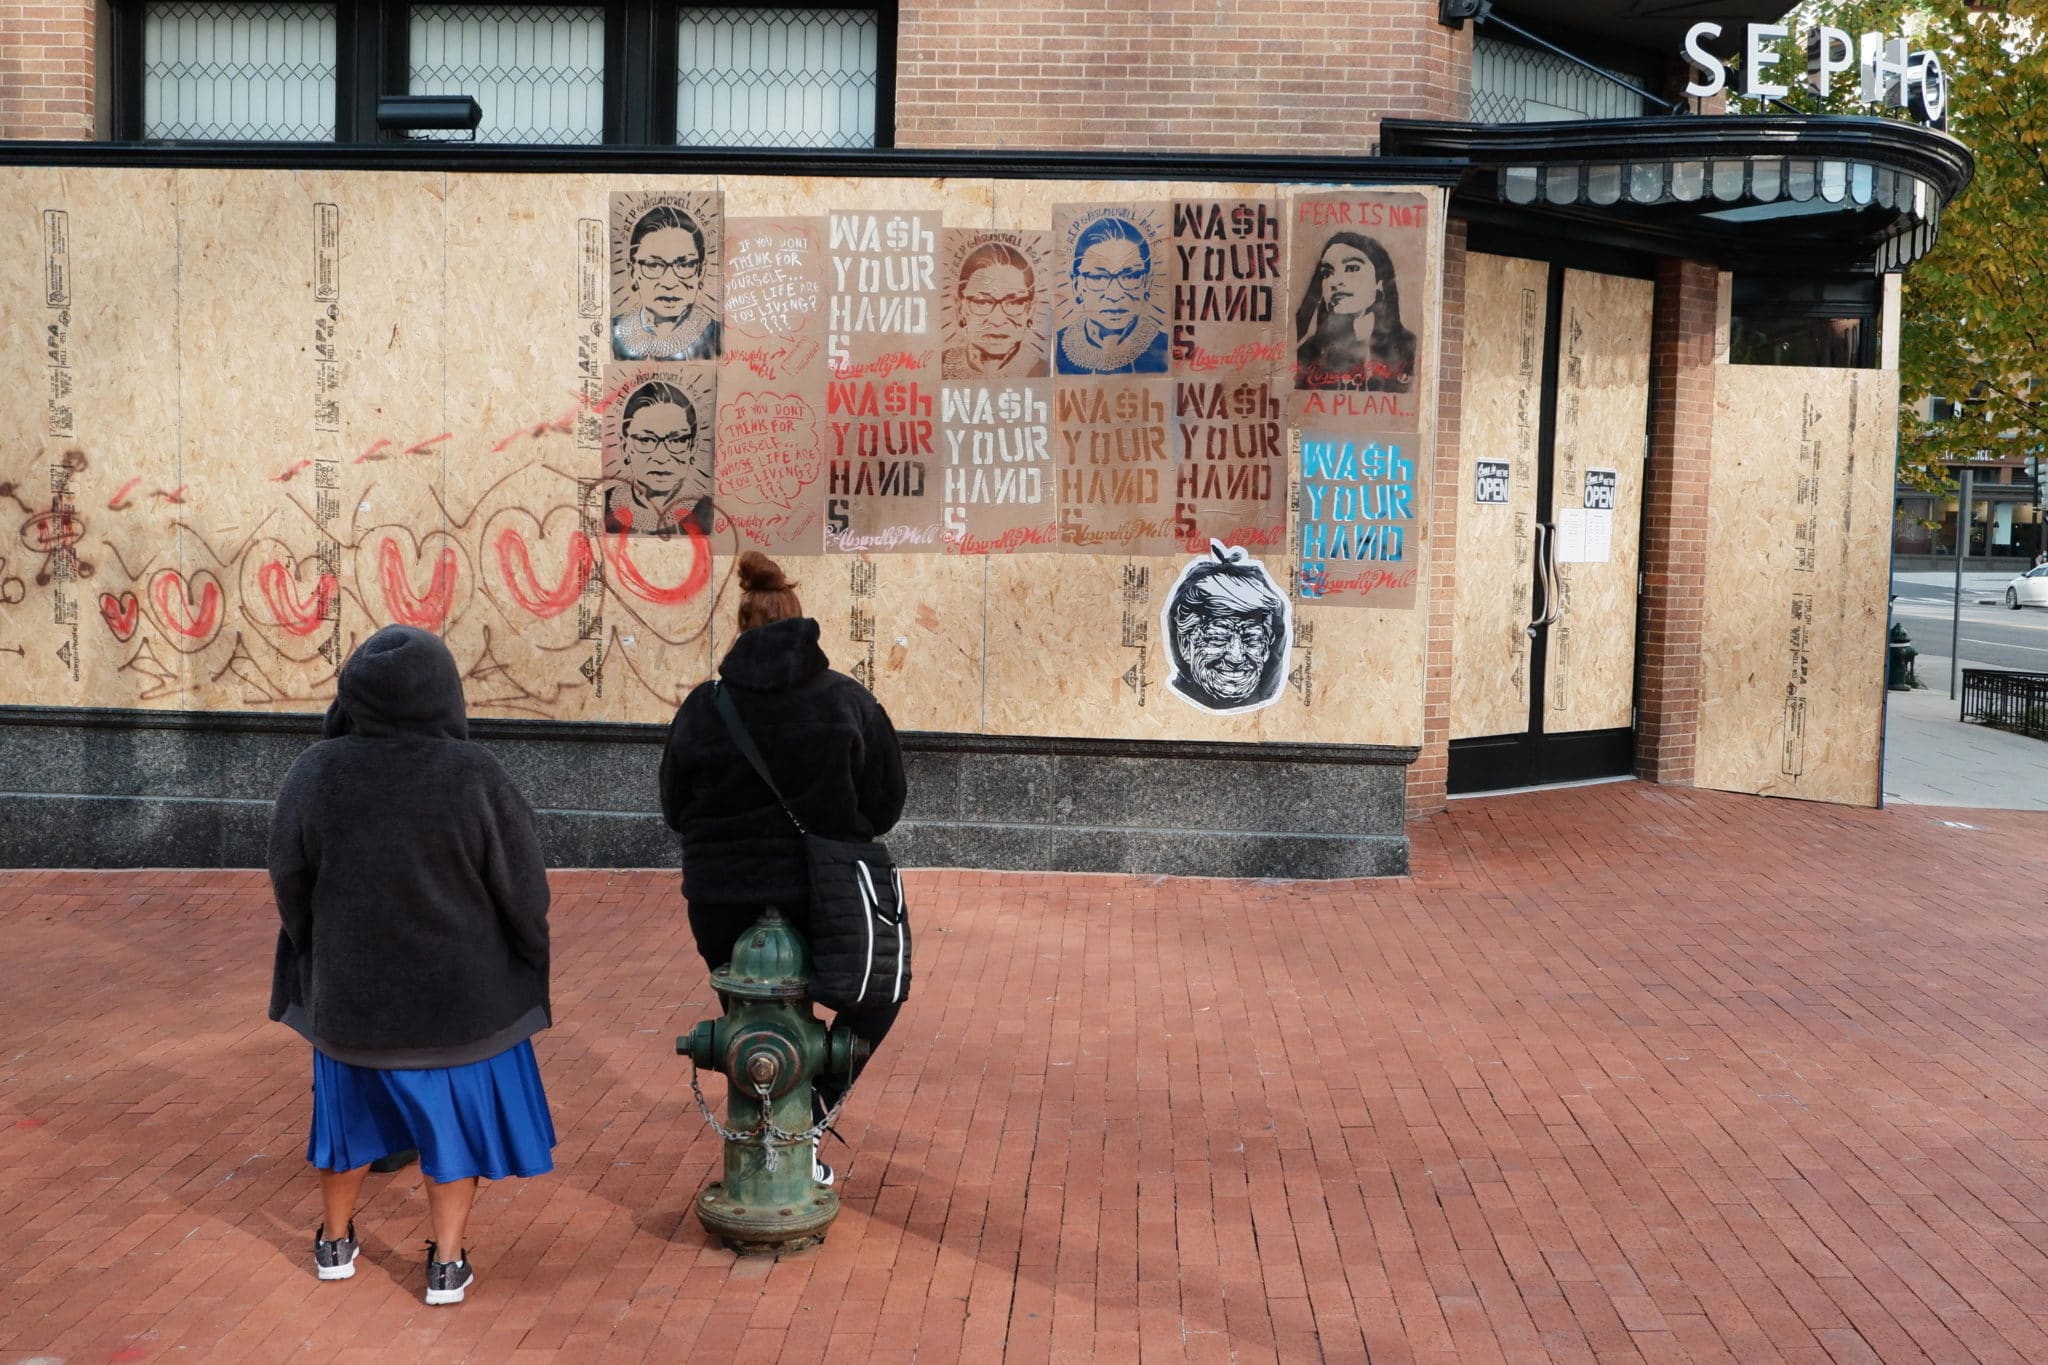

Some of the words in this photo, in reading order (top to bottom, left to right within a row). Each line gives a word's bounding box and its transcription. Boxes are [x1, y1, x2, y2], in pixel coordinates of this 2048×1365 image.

[1298, 201, 1353, 226] FEAR
[1358, 202, 1384, 225] IS
[1388, 204, 1427, 229] NOT
[738, 241, 751, 252] IF
[755, 237, 773, 248] YOU
[729, 252, 772, 271] THINK
[775, 253, 802, 266] FOR
[832, 255, 937, 293] YOUR
[1176, 242, 1281, 281] YOUR
[763, 282, 796, 301] LIFE
[731, 309, 753, 323] YOU
[759, 295, 817, 316] LIVING?
[48, 324, 60, 362] APA
[316, 318, 326, 356] APA
[579, 335, 590, 373] APA
[735, 408, 746, 420] IF
[751, 405, 769, 416] YOU
[1303, 392, 1327, 414] A
[1333, 393, 1415, 416] PLAN...
[725, 420, 769, 438] THINK
[770, 420, 796, 433] FOR
[831, 420, 935, 457] YOUR
[1179, 421, 1282, 460] YOUR
[946, 425, 1050, 465] YOUR
[1062, 426, 1168, 465] YOUR
[758, 451, 792, 468] LIFE
[726, 476, 750, 490] YOU
[753, 463, 813, 483] LIVING?
[1477, 477, 1508, 501] OPEN
[1306, 484, 1414, 521] YOUR
[1585, 486, 1613, 508] OPEN
[1800, 656, 1808, 685] APA
